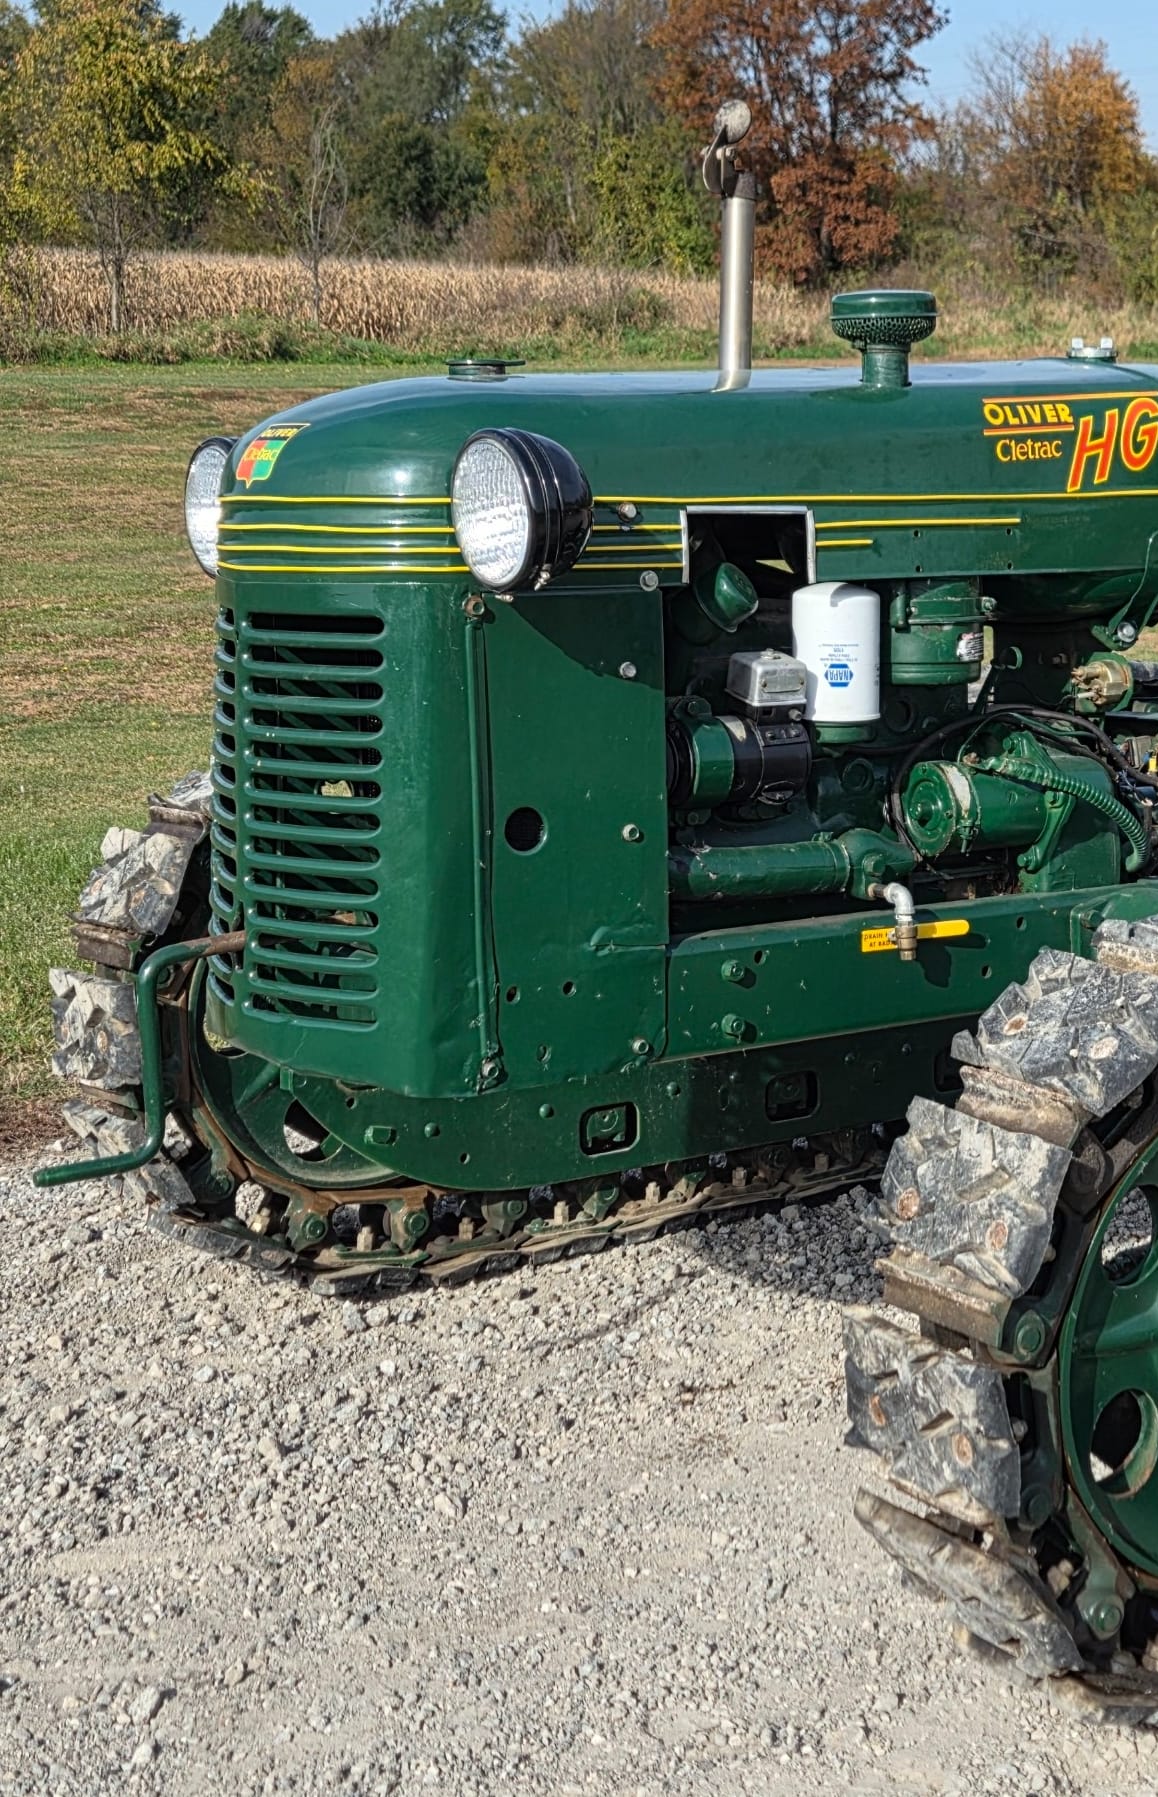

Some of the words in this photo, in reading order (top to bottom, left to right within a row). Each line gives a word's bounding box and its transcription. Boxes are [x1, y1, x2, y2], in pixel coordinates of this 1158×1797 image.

[984, 403, 1073, 425] OLIVER
[260, 428, 299, 437] OLIVER
[996, 439, 1062, 462] Cletrac
[829, 670, 849, 681] NAPA
[864, 932, 883, 941] DRAIN
